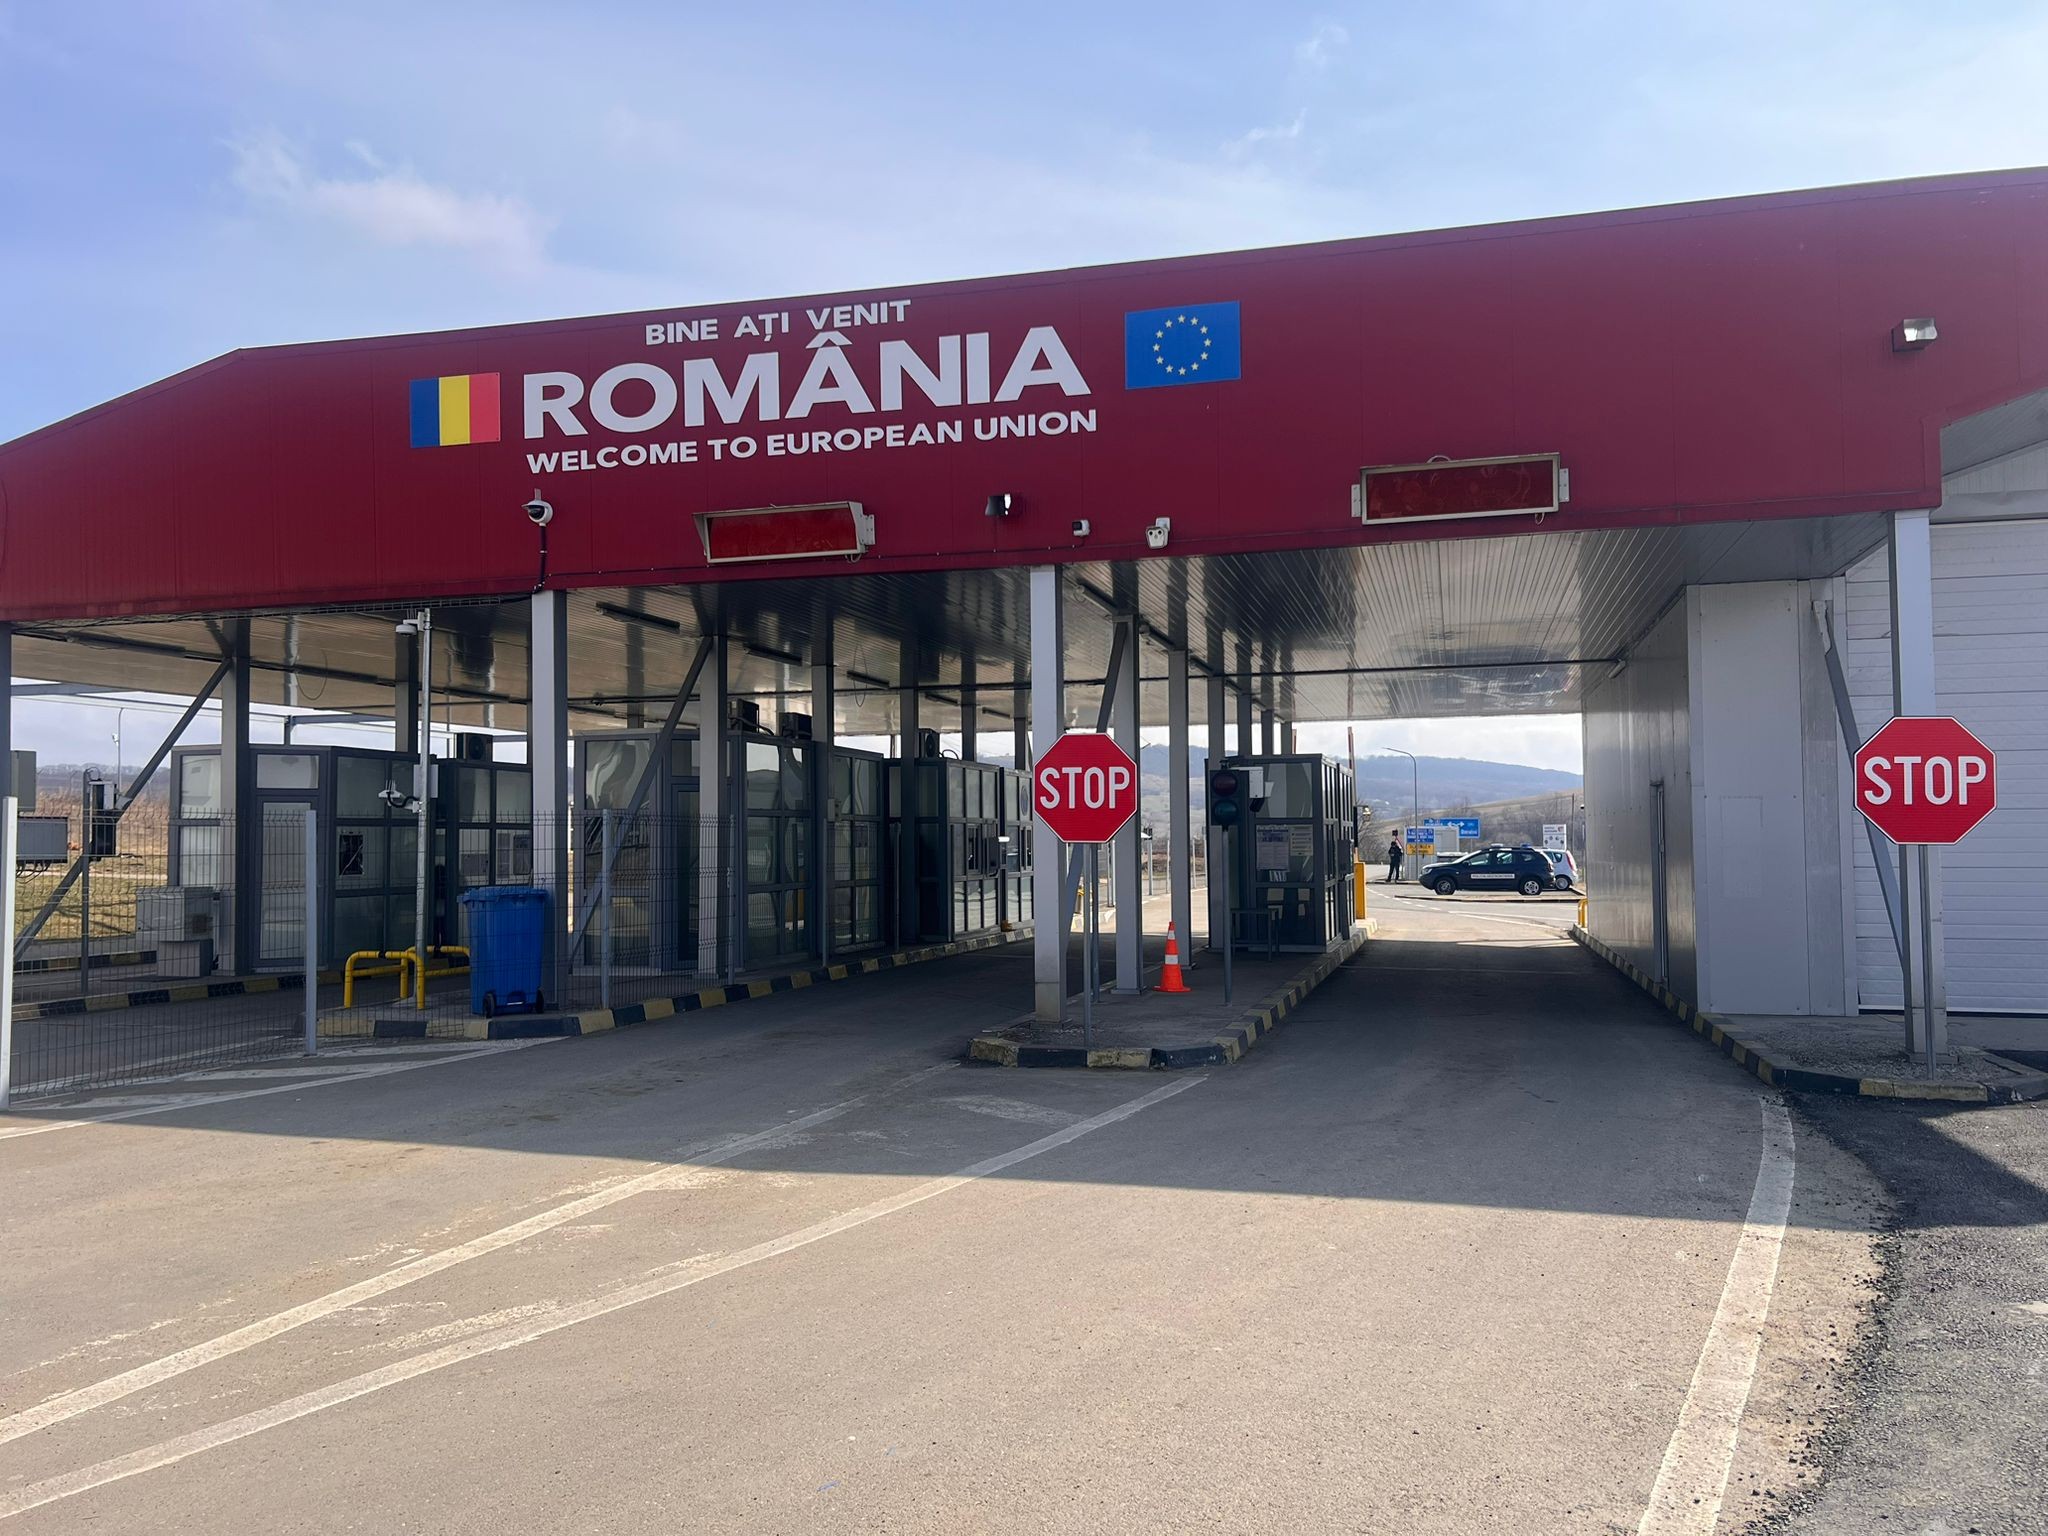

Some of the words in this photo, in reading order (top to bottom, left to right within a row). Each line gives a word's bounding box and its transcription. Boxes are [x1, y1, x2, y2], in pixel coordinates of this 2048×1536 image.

[646, 319, 718, 345] BINE
[806, 299, 911, 330] VENIT
[524, 326, 1091, 439] ROMÂNIA
[527, 441, 698, 473] WELCOME
[707, 436, 757, 460] TO
[767, 420, 962, 456] EUROPEAN
[974, 409, 1096, 440] UNION
[1040, 767, 1130, 809] STOP
[1864, 756, 1987, 805] STOP
